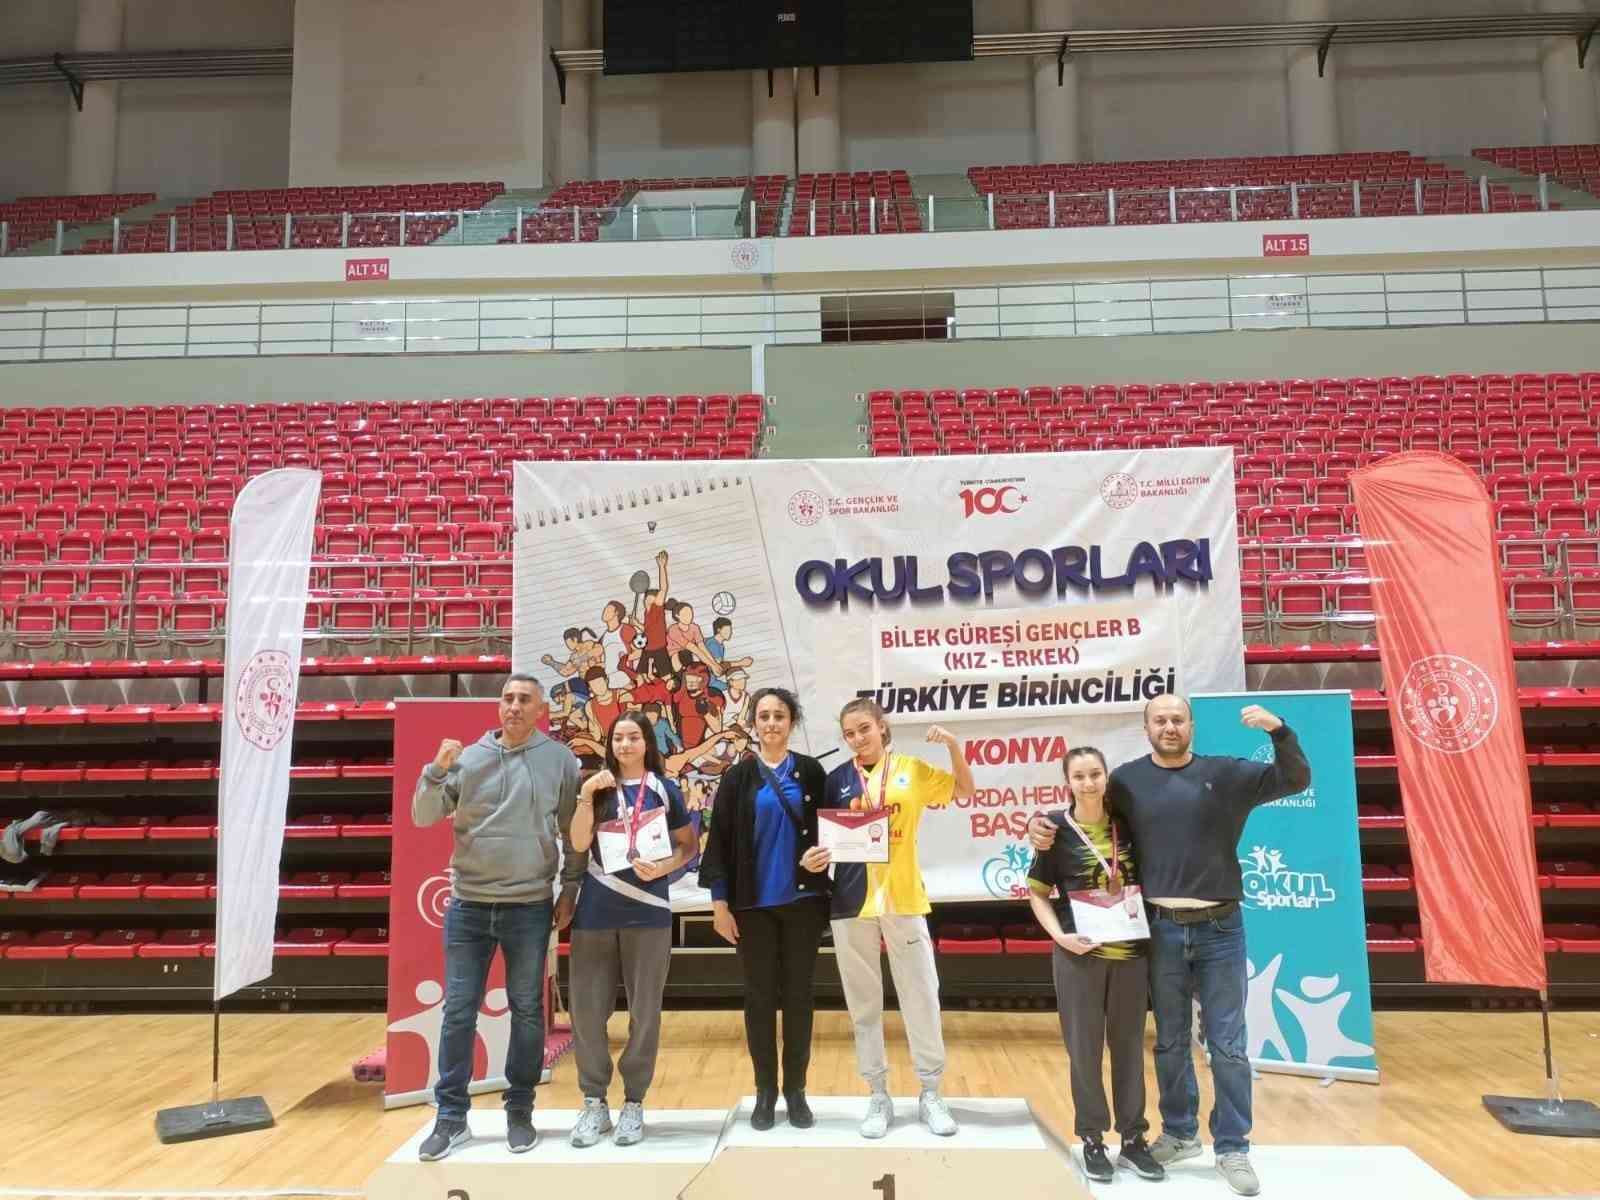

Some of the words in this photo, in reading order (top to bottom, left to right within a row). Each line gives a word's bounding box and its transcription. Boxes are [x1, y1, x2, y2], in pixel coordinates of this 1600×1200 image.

[1265, 239, 1288, 251] ALT
[1290, 238, 1307, 251] 15
[348, 264, 368, 276] ALT
[372, 263, 387, 275] 14
[887, 495, 898, 503] VE
[1140, 487, 1187, 497] BAKANLIĞI
[829, 507, 849, 515] SPOR
[853, 504, 899, 513] BAKANLIĞI
[795, 555, 943, 607] OKUL
[947, 537, 1214, 602] SPORLARI
[881, 626, 940, 648] BİLEK
[945, 620, 1021, 647] GÜREŞİ
[1026, 619, 1123, 645] GENÇLER
[1128, 618, 1141, 635] B
[944, 651, 986, 670] (KIZ
[1002, 646, 1080, 668] ERKEK)
[856, 679, 987, 714] TÜRKİYE
[998, 668, 1175, 707] BİRİNCİLİĞİ
[965, 736, 1068, 766] KONYA
[1241, 870, 1335, 902] OKUL
